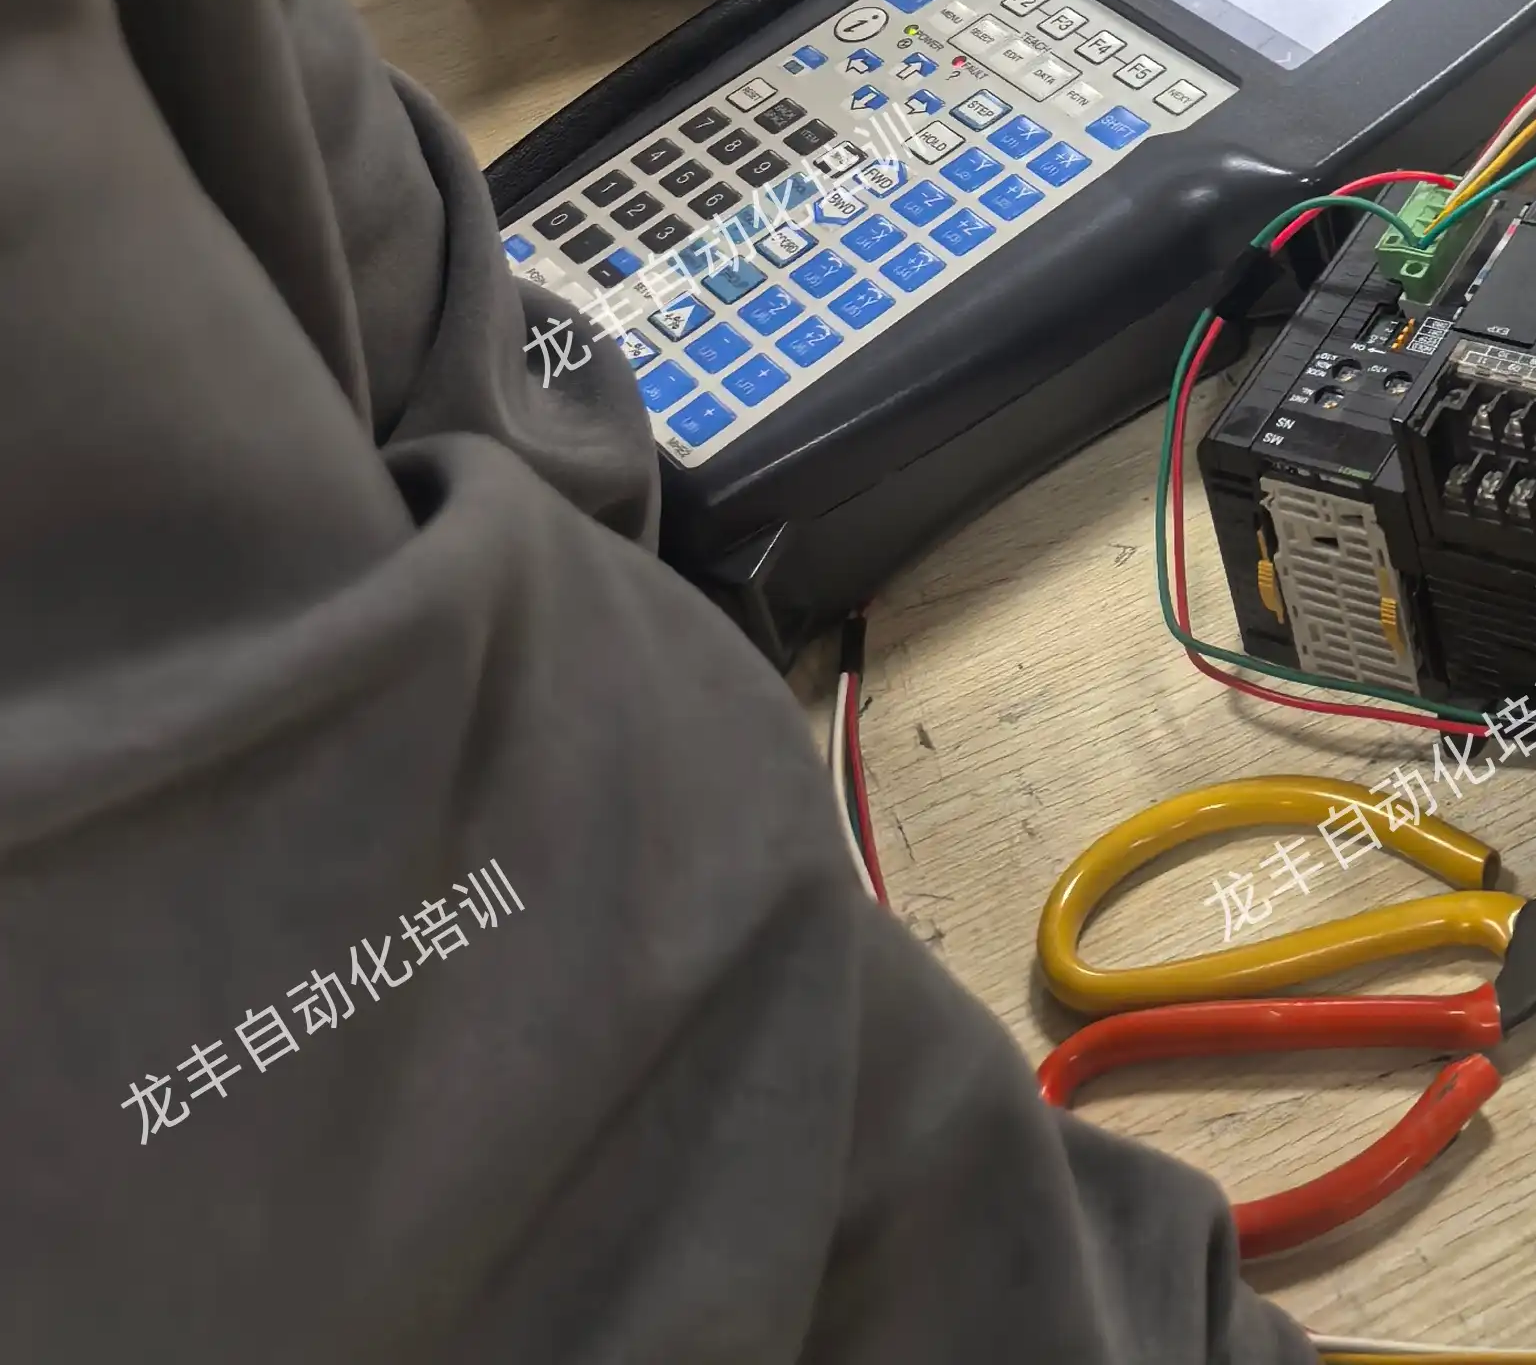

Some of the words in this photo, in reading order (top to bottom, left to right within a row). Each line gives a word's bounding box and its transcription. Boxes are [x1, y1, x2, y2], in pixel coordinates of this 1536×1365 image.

[941, 8, 964, 25] MENU
[1050, 14, 1074, 31] F3
[916, 30, 945, 51] POWER
[1021, 31, 1052, 54] TEACH
[1088, 38, 1112, 54] F4
[1002, 48, 1025, 62] EDIT
[961, 61, 990, 80] FAULT
[1033, 69, 1056, 85] DATA
[1127, 63, 1152, 80] F5
[1067, 90, 1089, 106] FCTN
[1167, 89, 1193, 104] NEXT
[966, 100, 994, 118] STEP
[696, 118, 715, 130] 7
[1100, 115, 1135, 138] SHIFT
[725, 139, 742, 152] 8
[919, 131, 947, 152] HOLD
[650, 150, 667, 162] 4
[754, 161, 771, 174] 9
[676, 171, 695, 184] 5
[862, 169, 893, 189] FWD
[601, 182, 617, 193] 1
[705, 193, 724, 207] 6
[828, 193, 857, 216] BWD
[626, 203, 646, 217] 2
[550, 213, 568, 226] 0
[656, 226, 675, 240] 3
[1351, 342, 1367, 352] ON
[1275, 417, 1296, 430] NS
[1263, 432, 1285, 446] MS
